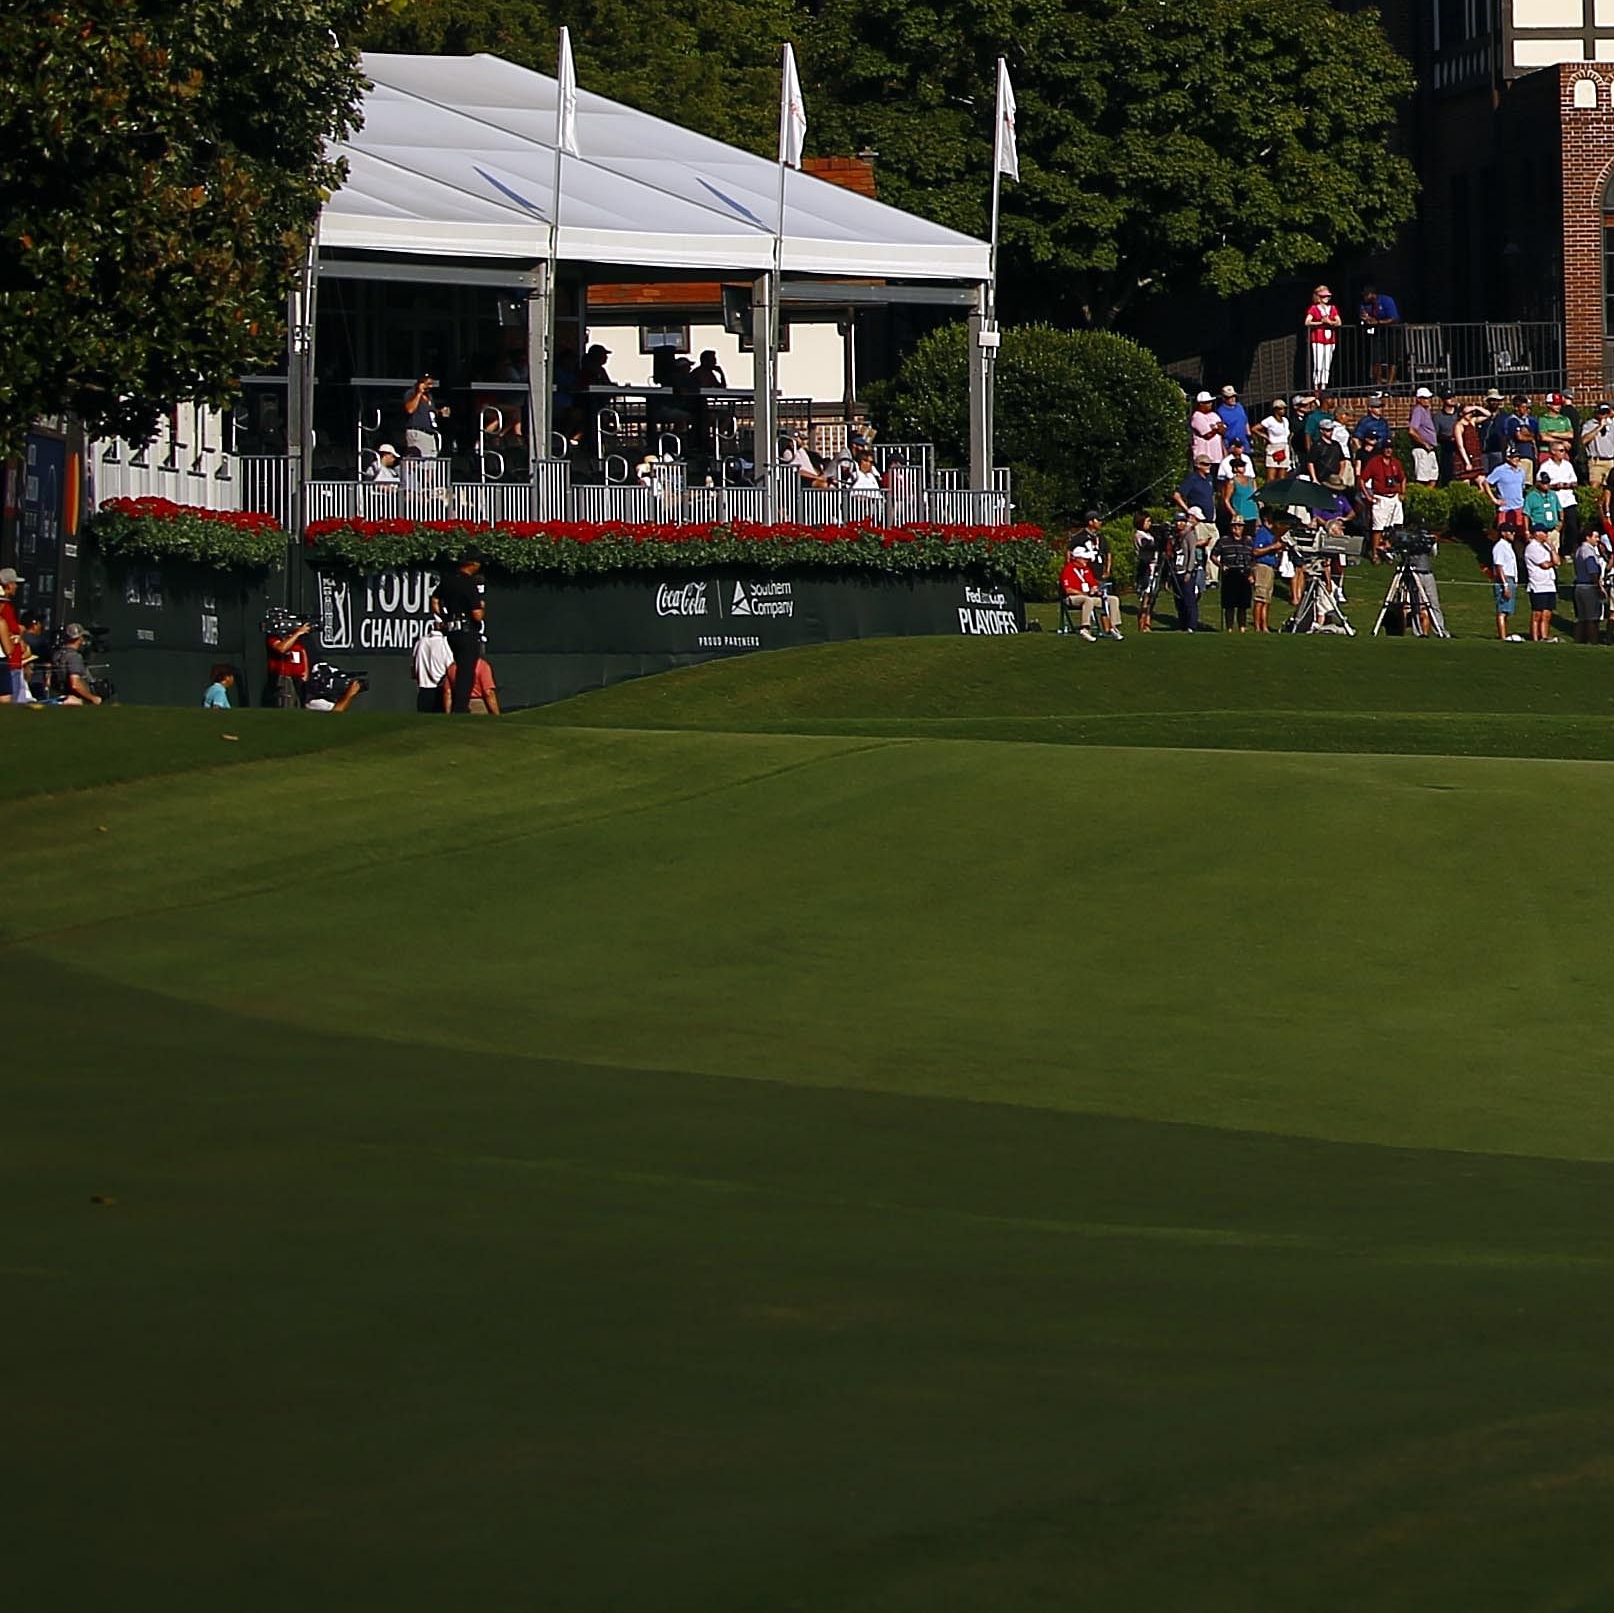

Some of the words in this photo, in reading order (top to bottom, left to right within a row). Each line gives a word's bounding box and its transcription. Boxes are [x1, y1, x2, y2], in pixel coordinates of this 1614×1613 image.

[750, 580, 792, 597] Southern
[751, 598, 794, 619] Company
[958, 607, 1018, 635] PLAYOFFS
[698, 636, 722, 647] PROUD
[724, 636, 760, 647] PARTNERS
